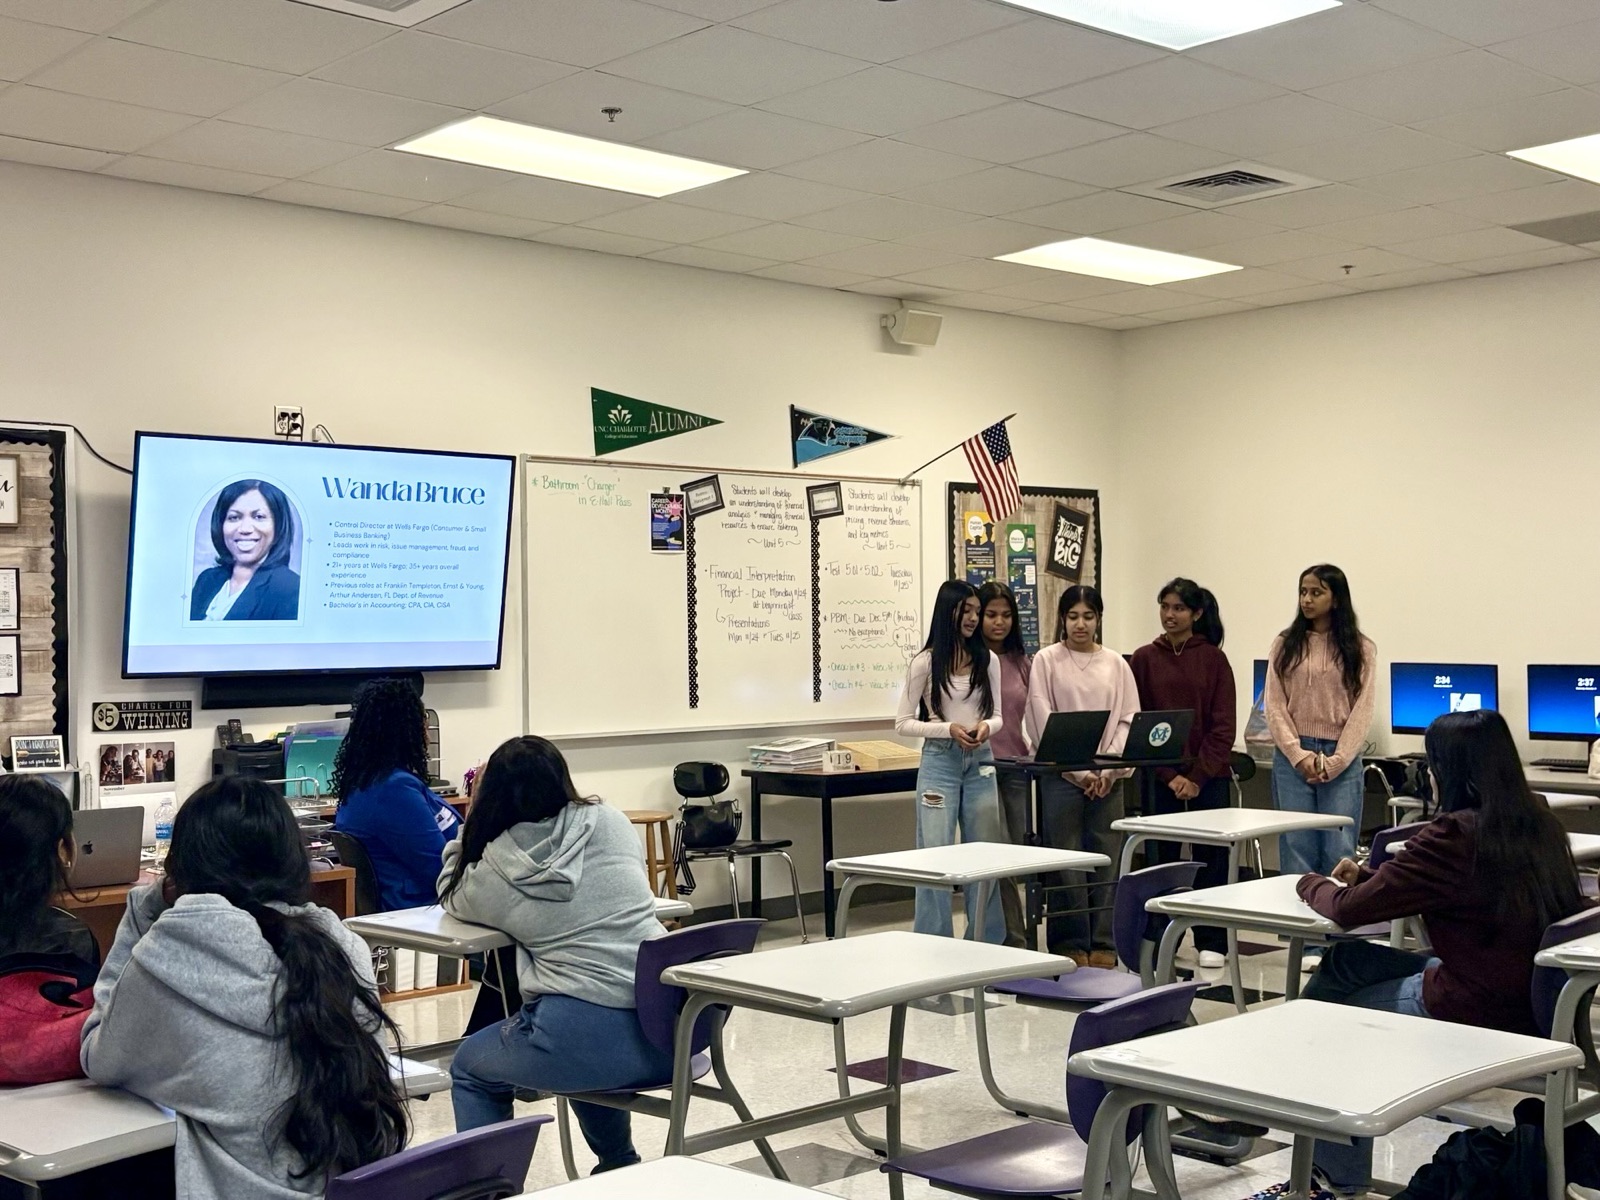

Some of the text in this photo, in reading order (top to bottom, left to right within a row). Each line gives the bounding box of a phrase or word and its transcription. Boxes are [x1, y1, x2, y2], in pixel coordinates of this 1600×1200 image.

[648, 410, 702, 434] ALUMNI
[542, 475, 579, 490] Bathroom
[322, 477, 486, 505] Wanda Bruce
[731, 484, 792, 500] Students will develop
[848, 488, 875, 500] Students
[890, 491, 910, 506] develop
[616, 495, 632, 506] Pass
[738, 499, 776, 514] understanding
[728, 510, 751, 522] analysis
[759, 513, 782, 524] managing
[855, 504, 894, 520] understanding
[364, 532, 390, 540] Banking)
[848, 530, 857, 539] and
[870, 530, 889, 538] metrics
[763, 538, 784, 548] Unit 5
[889, 540, 894, 550] 5
[710, 564, 795, 582] Financial Interpretation
[717, 584, 743, 604] Project
[751, 588, 766, 598] Due
[769, 587, 793, 602] Monday
[726, 614, 770, 628] Presentations
[854, 613, 866, 624] Due
[1577, 678, 1595, 686] 2:37
[98, 708, 114, 726] $5
[122, 712, 188, 729] WHINING
[46, 740, 60, 748] BACK
